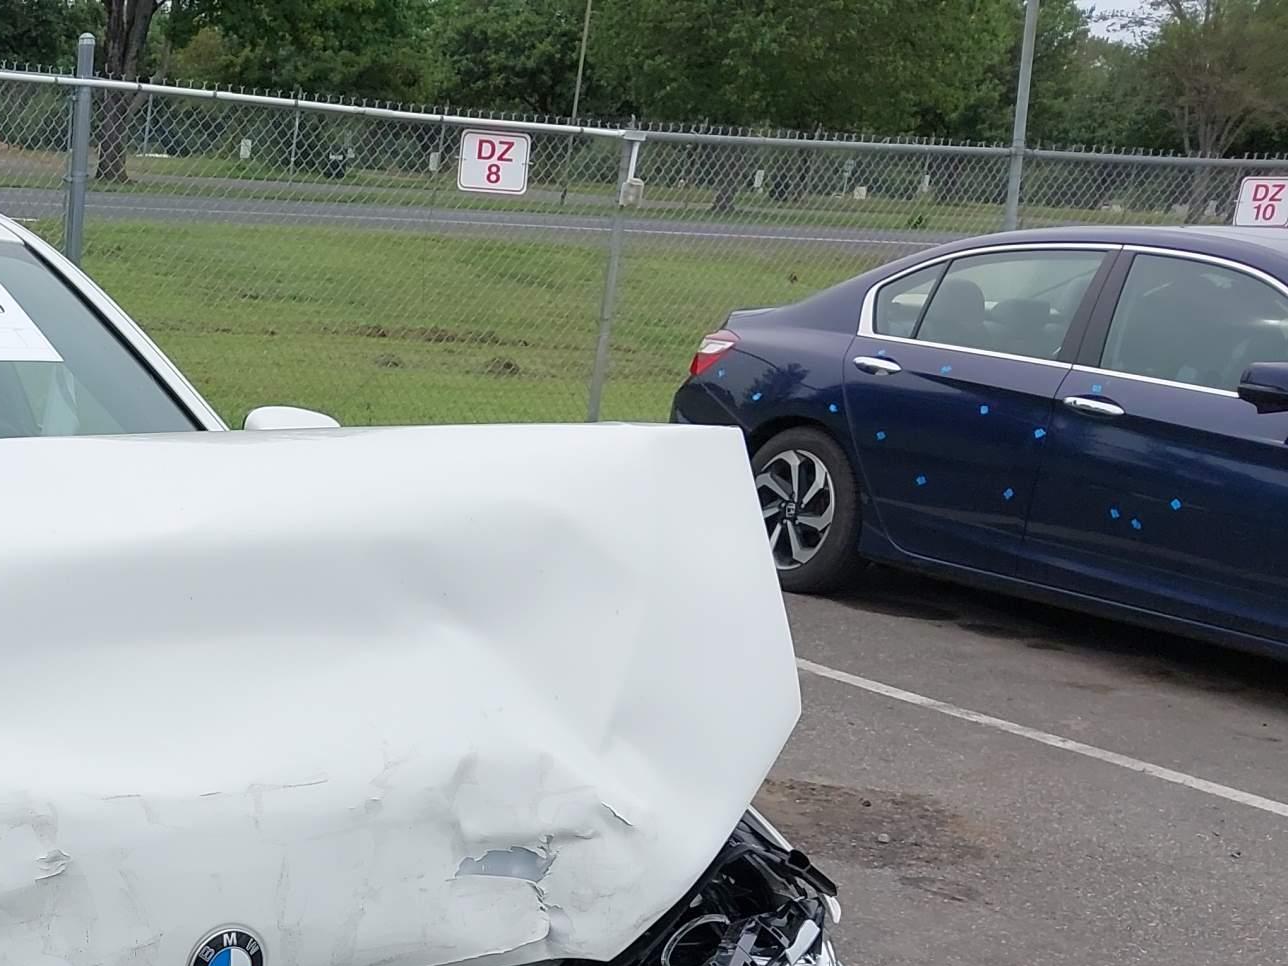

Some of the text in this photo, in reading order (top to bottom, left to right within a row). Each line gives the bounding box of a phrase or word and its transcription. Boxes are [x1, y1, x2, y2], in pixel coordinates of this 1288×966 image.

[477, 139, 515, 162] DZ
[486, 164, 501, 183] 8
[1252, 184, 1286, 202] DZ
[1253, 204, 1276, 221] 10
[198, 932, 260, 963] BMW
